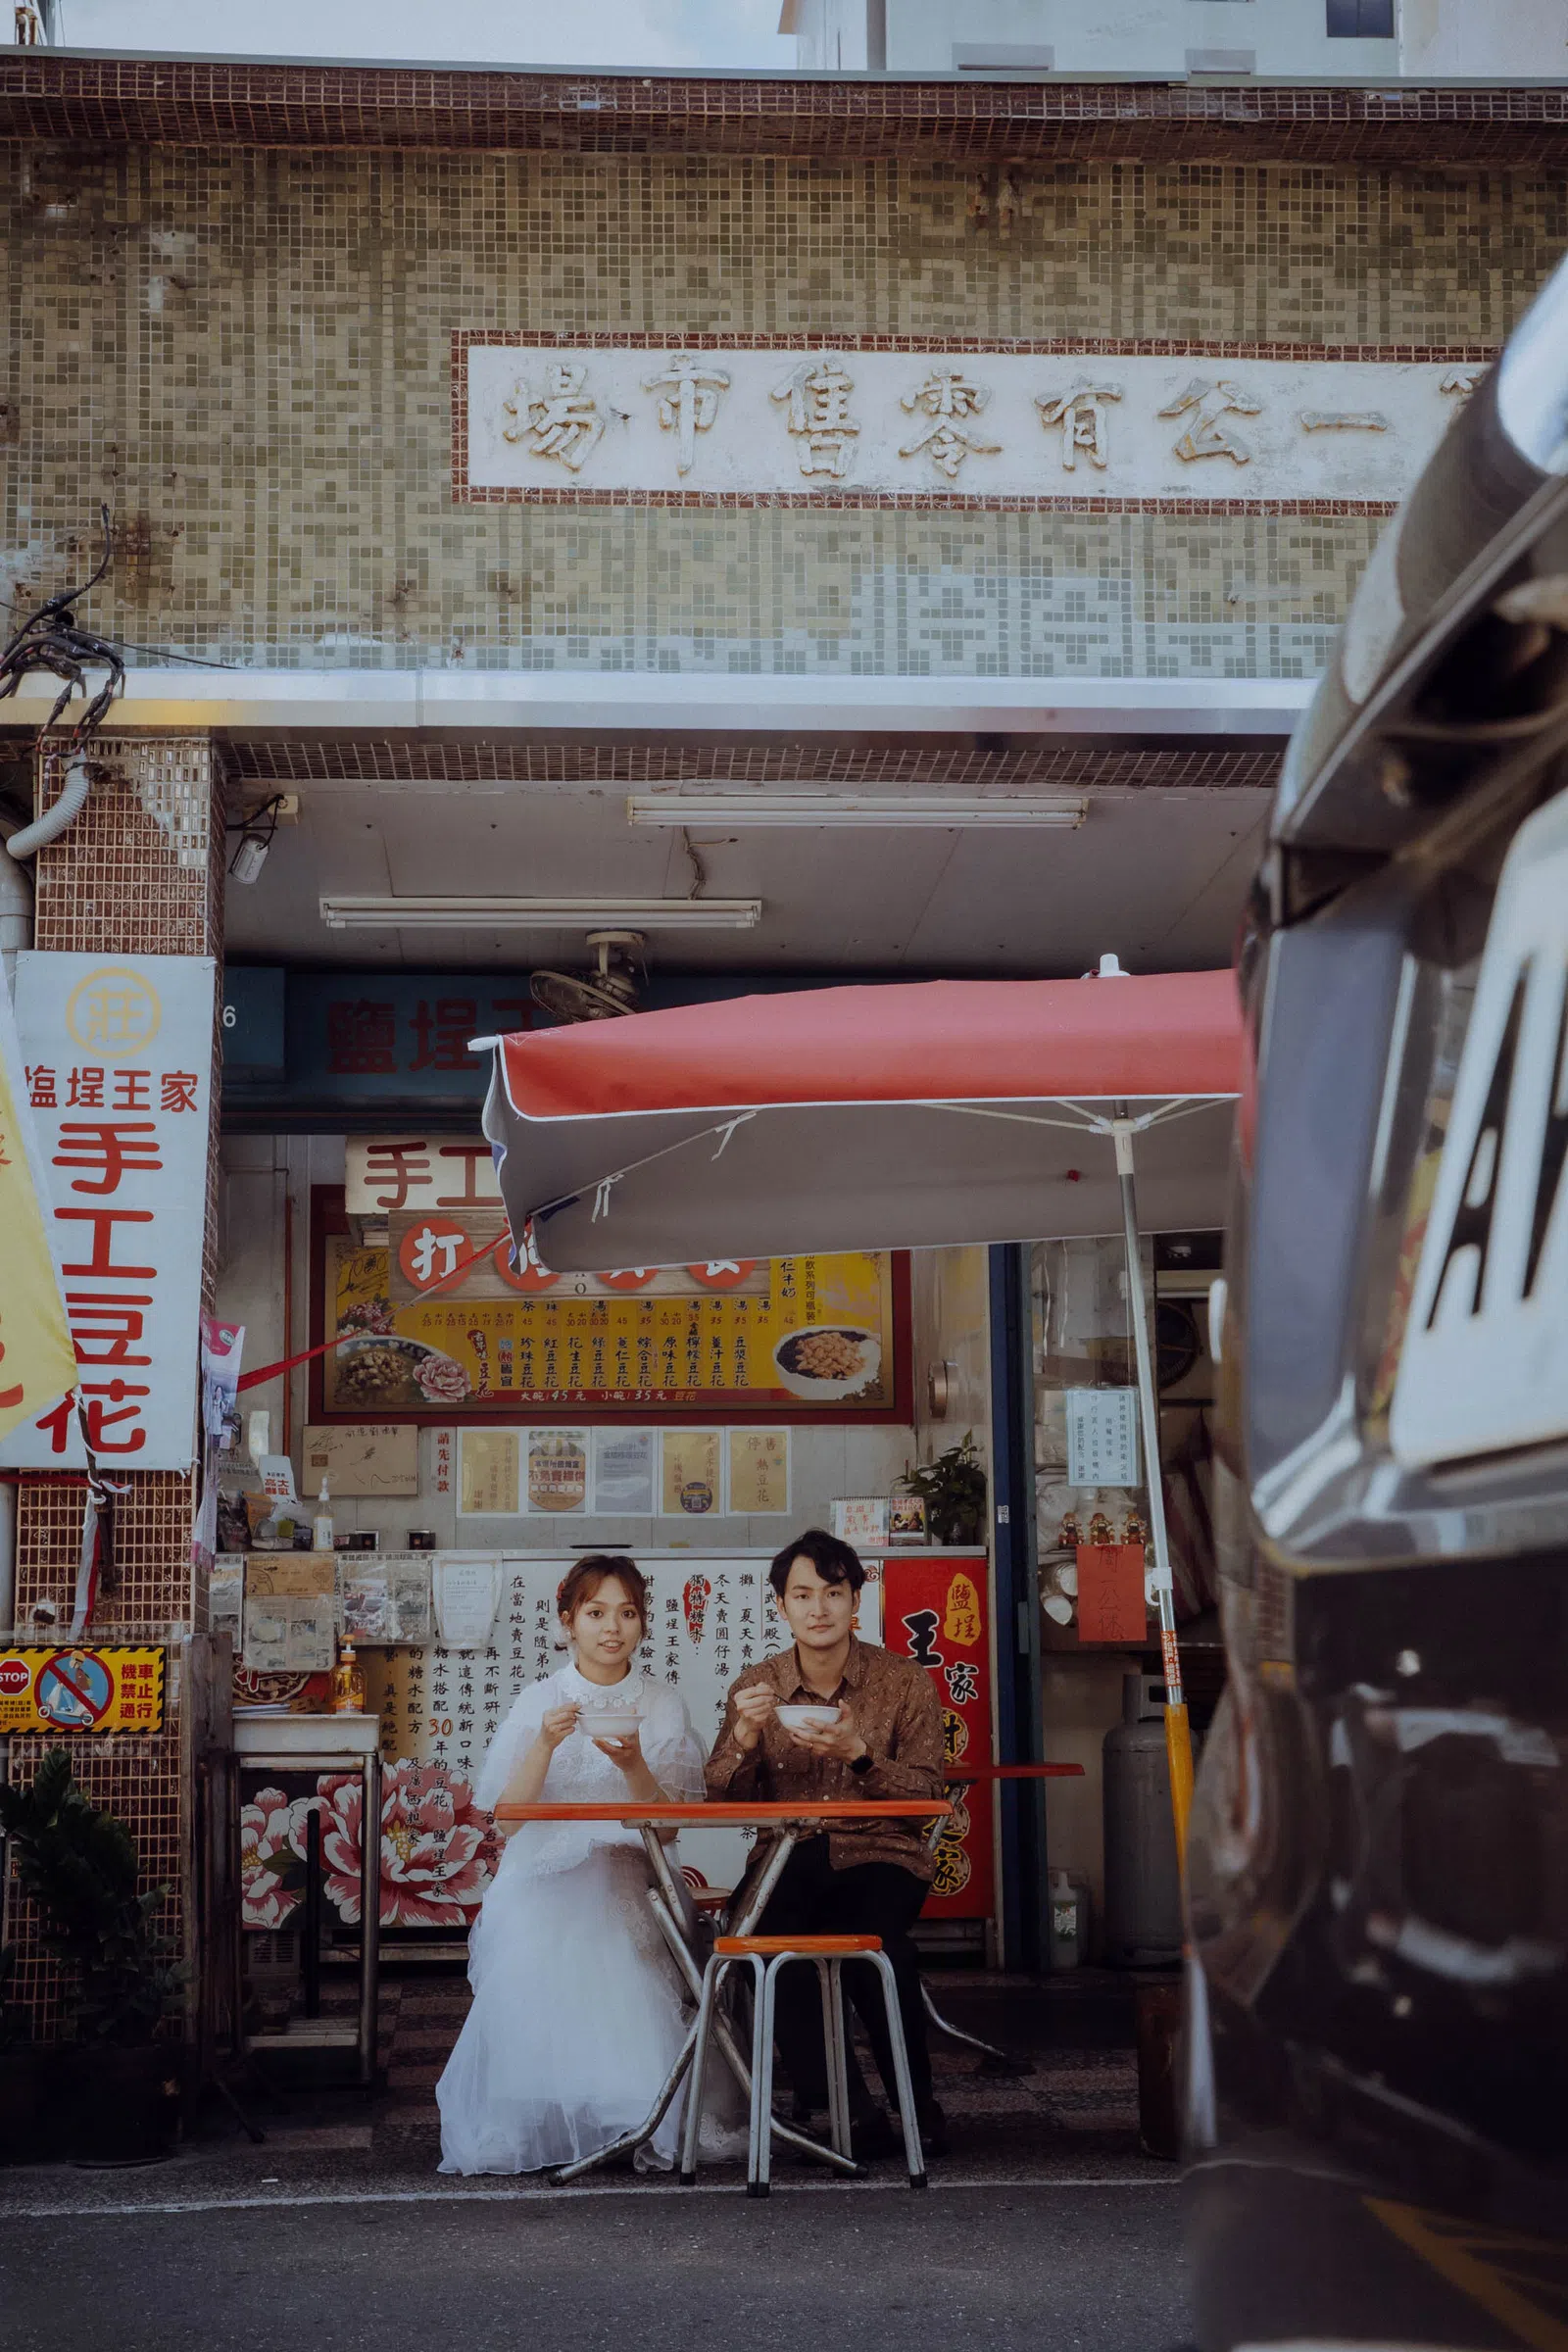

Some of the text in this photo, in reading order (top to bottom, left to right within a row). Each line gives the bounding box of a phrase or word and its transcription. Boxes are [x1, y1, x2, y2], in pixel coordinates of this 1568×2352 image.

[364, 1142, 505, 1209] 手工
[35, 1122, 163, 1453] 手工豆花
[780, 1257, 796, 1298] 仁牛奶
[519, 1337, 536, 1388] 珍珠豆花
[544, 1338, 559, 1388] 紅豆豆花
[567, 1337, 583, 1388] 花生豆花
[662, 1337, 678, 1387] 原味豆花
[437, 1432, 451, 1494] 請先付款
[510, 1575, 525, 1708] 在當地賣豆花三
[121, 1684, 153, 1699] 禁止
[122, 1663, 154, 1680] 機車
[120, 1703, 153, 1719] 通行
